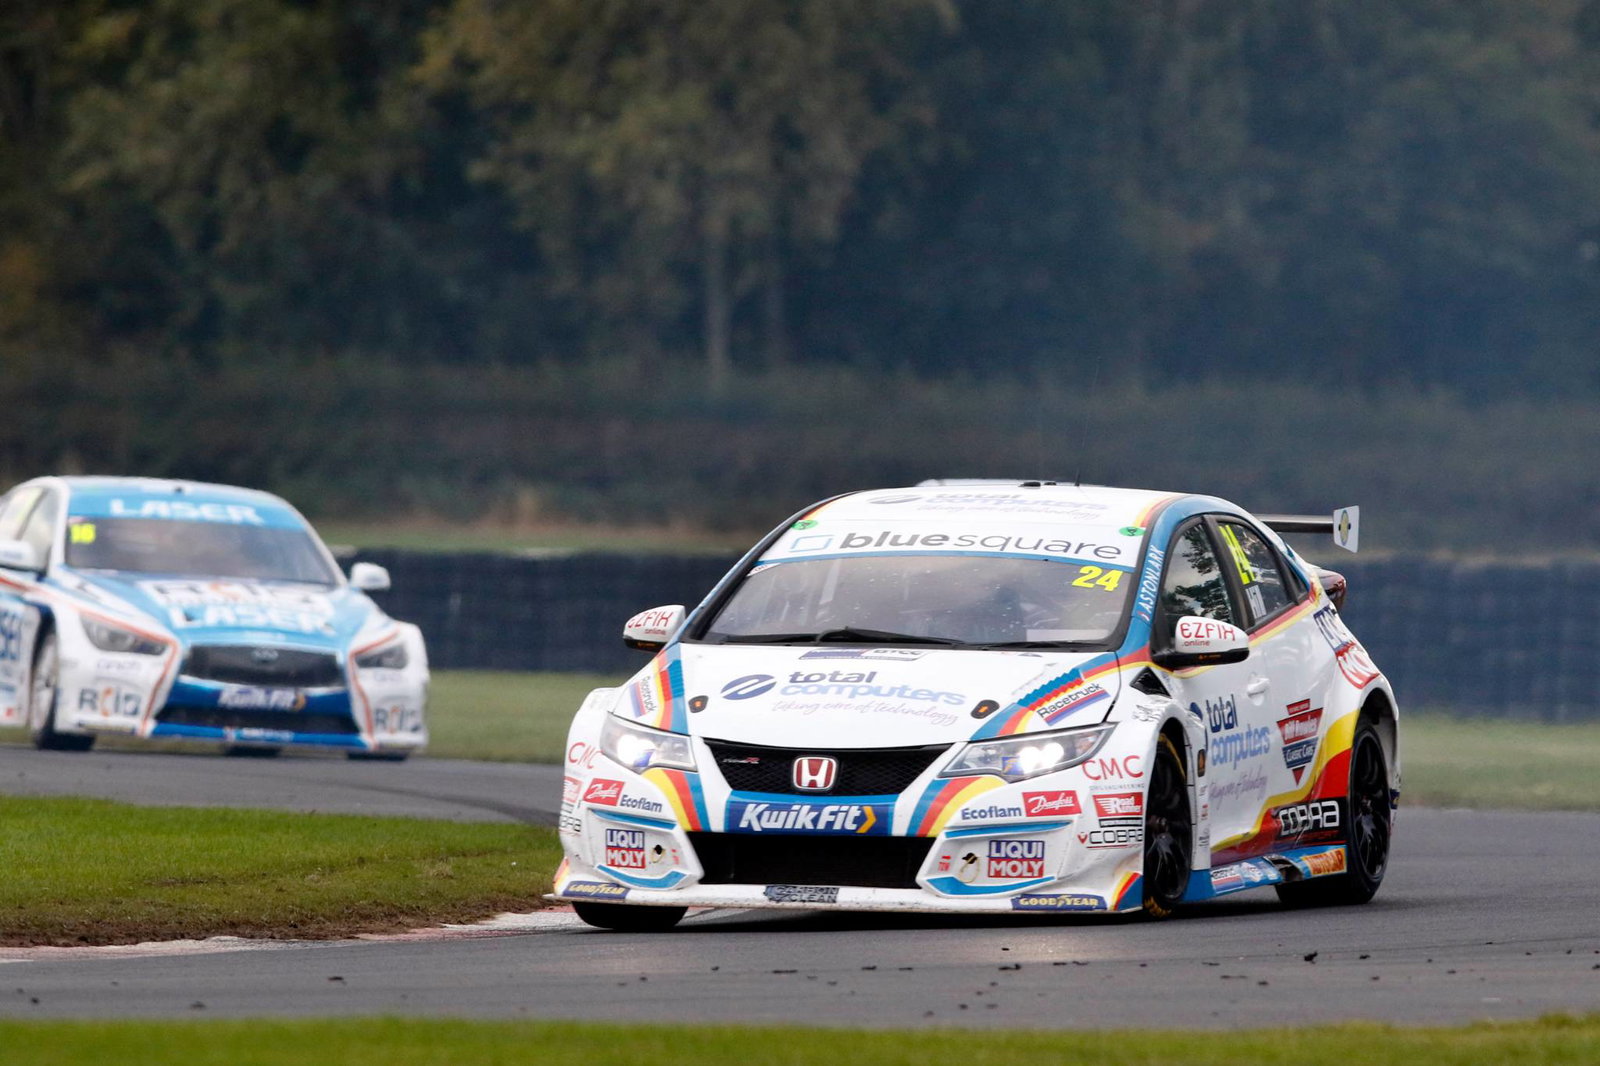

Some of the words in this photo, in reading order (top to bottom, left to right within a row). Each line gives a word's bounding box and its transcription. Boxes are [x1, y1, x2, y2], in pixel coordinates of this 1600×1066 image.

[109, 498, 265, 526] LASER
[1071, 565, 1123, 592] 24
[789, 670, 877, 684] total
[780, 684, 968, 706] computers
[1036, 683, 1103, 719] Racetruck
[1206, 693, 1239, 733] total
[1211, 723, 1271, 770] computers
[1082, 755, 1144, 780] CMC
[620, 795, 663, 813] Ecoflam
[961, 805, 1022, 820] Ecoflam
[1280, 800, 1340, 837] COBRA
[607, 830, 644, 848] LIQUI
[607, 850, 645, 868] MOLY
[990, 841, 1043, 858] LIQUI
[989, 858, 1044, 877] MOLY
[775, 886, 839, 895] CARBON
[792, 894, 837, 903] CLEAN
